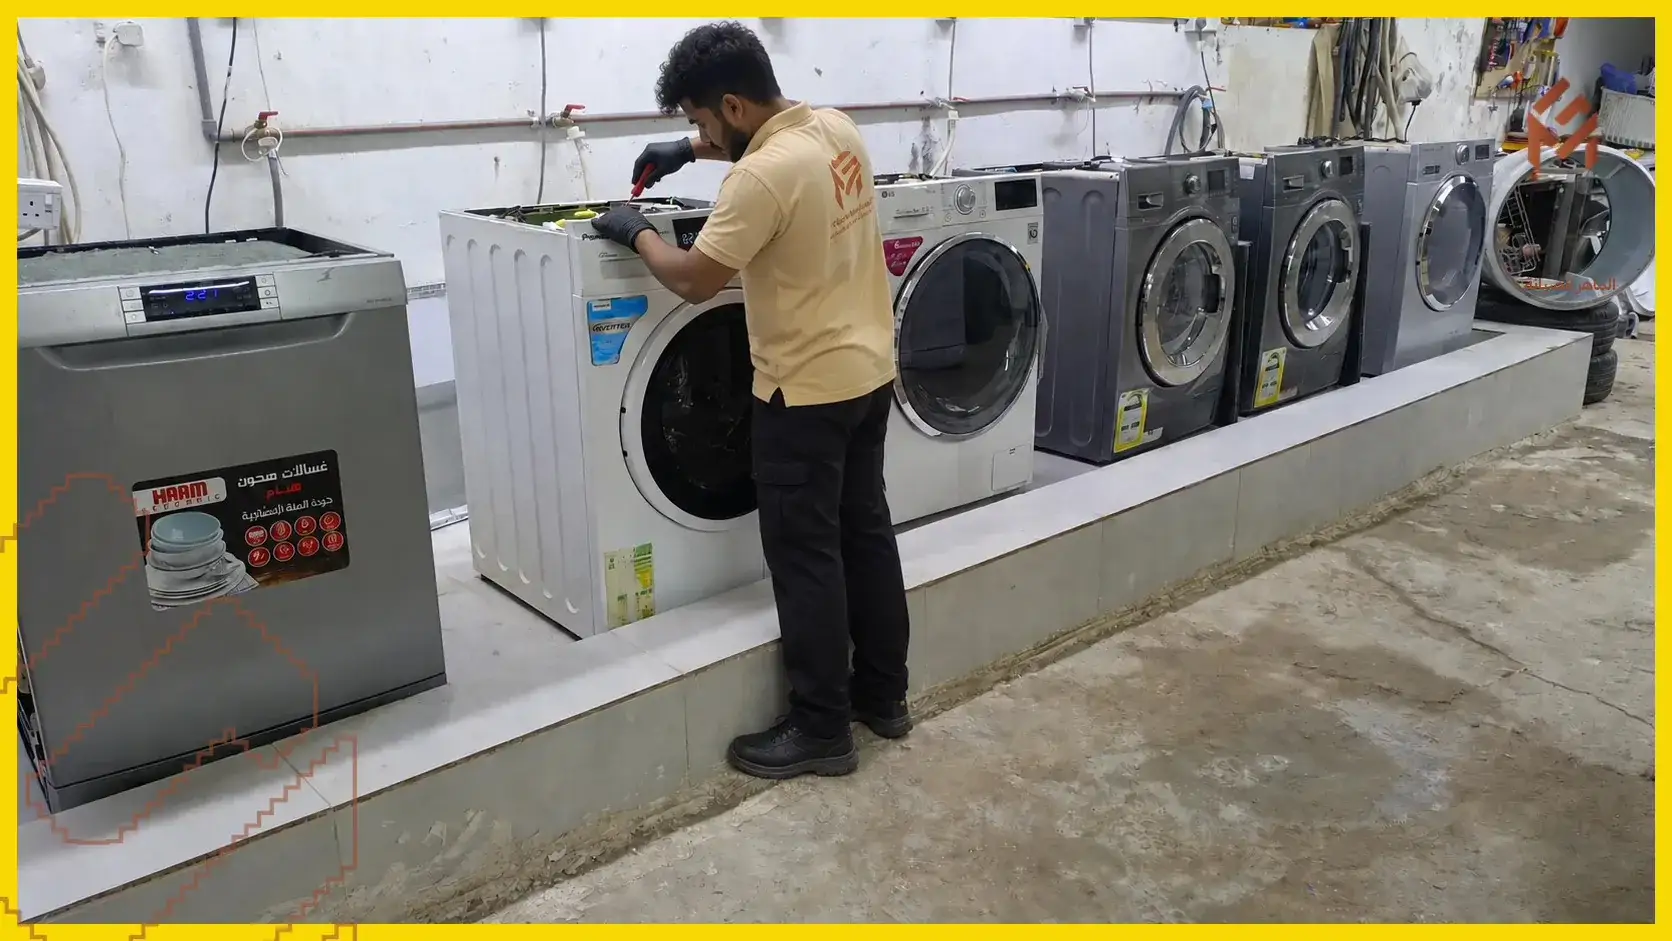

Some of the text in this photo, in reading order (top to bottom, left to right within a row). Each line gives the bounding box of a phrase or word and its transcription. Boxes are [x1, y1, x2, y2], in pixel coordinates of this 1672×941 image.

[237, 460, 329, 488] غسالات صحون
[152, 481, 208, 505] HAAM
